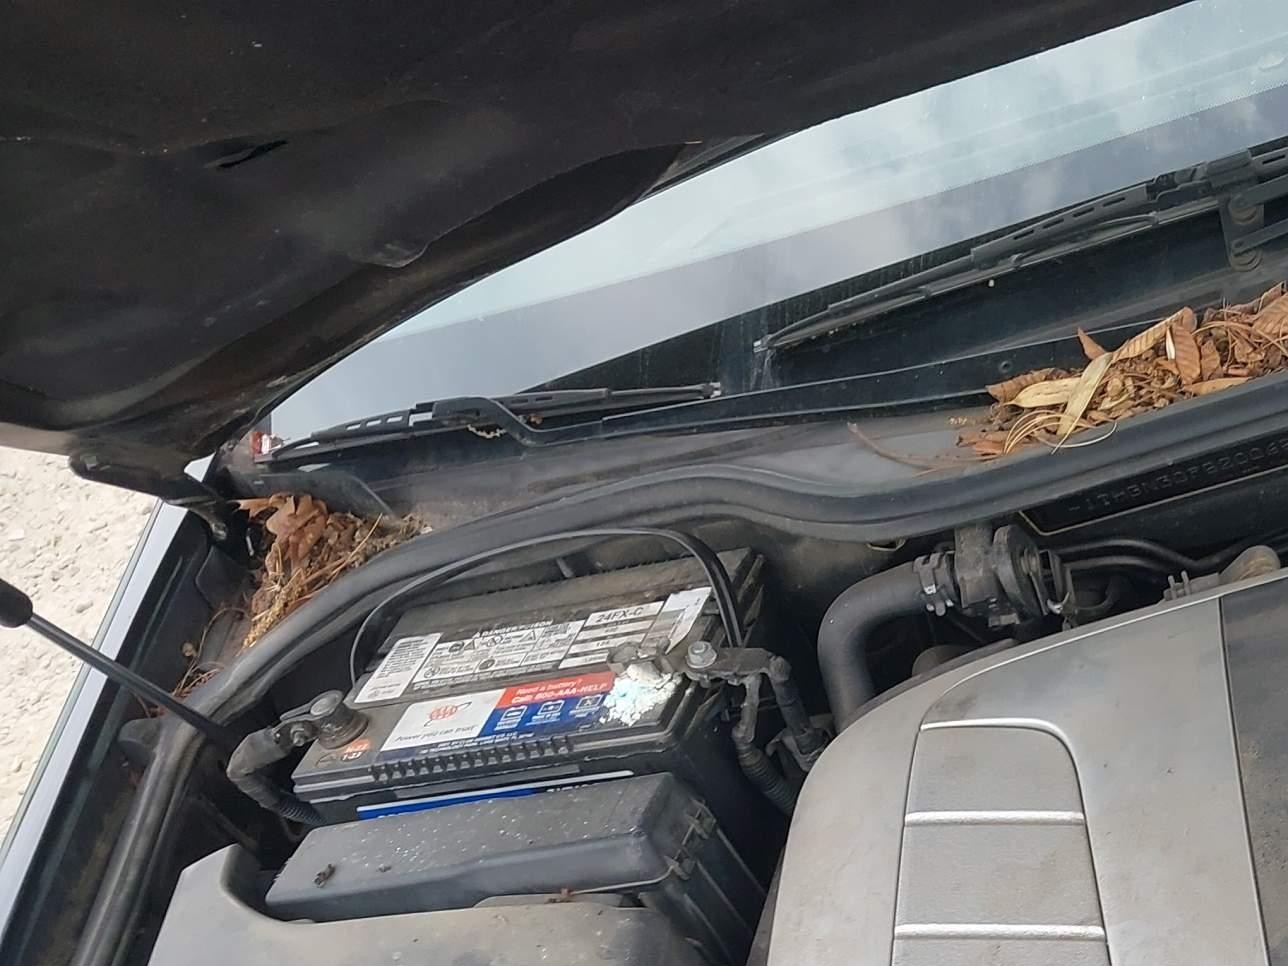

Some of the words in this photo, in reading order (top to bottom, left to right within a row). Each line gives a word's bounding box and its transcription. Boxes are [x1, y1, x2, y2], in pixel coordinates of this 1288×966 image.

[595, 607, 644, 623] 24FX-C
[511, 694, 533, 704] Call
[533, 683, 608, 701] 800-AAA-HELP
[517, 685, 539, 695] Need
[422, 731, 438, 741] you
